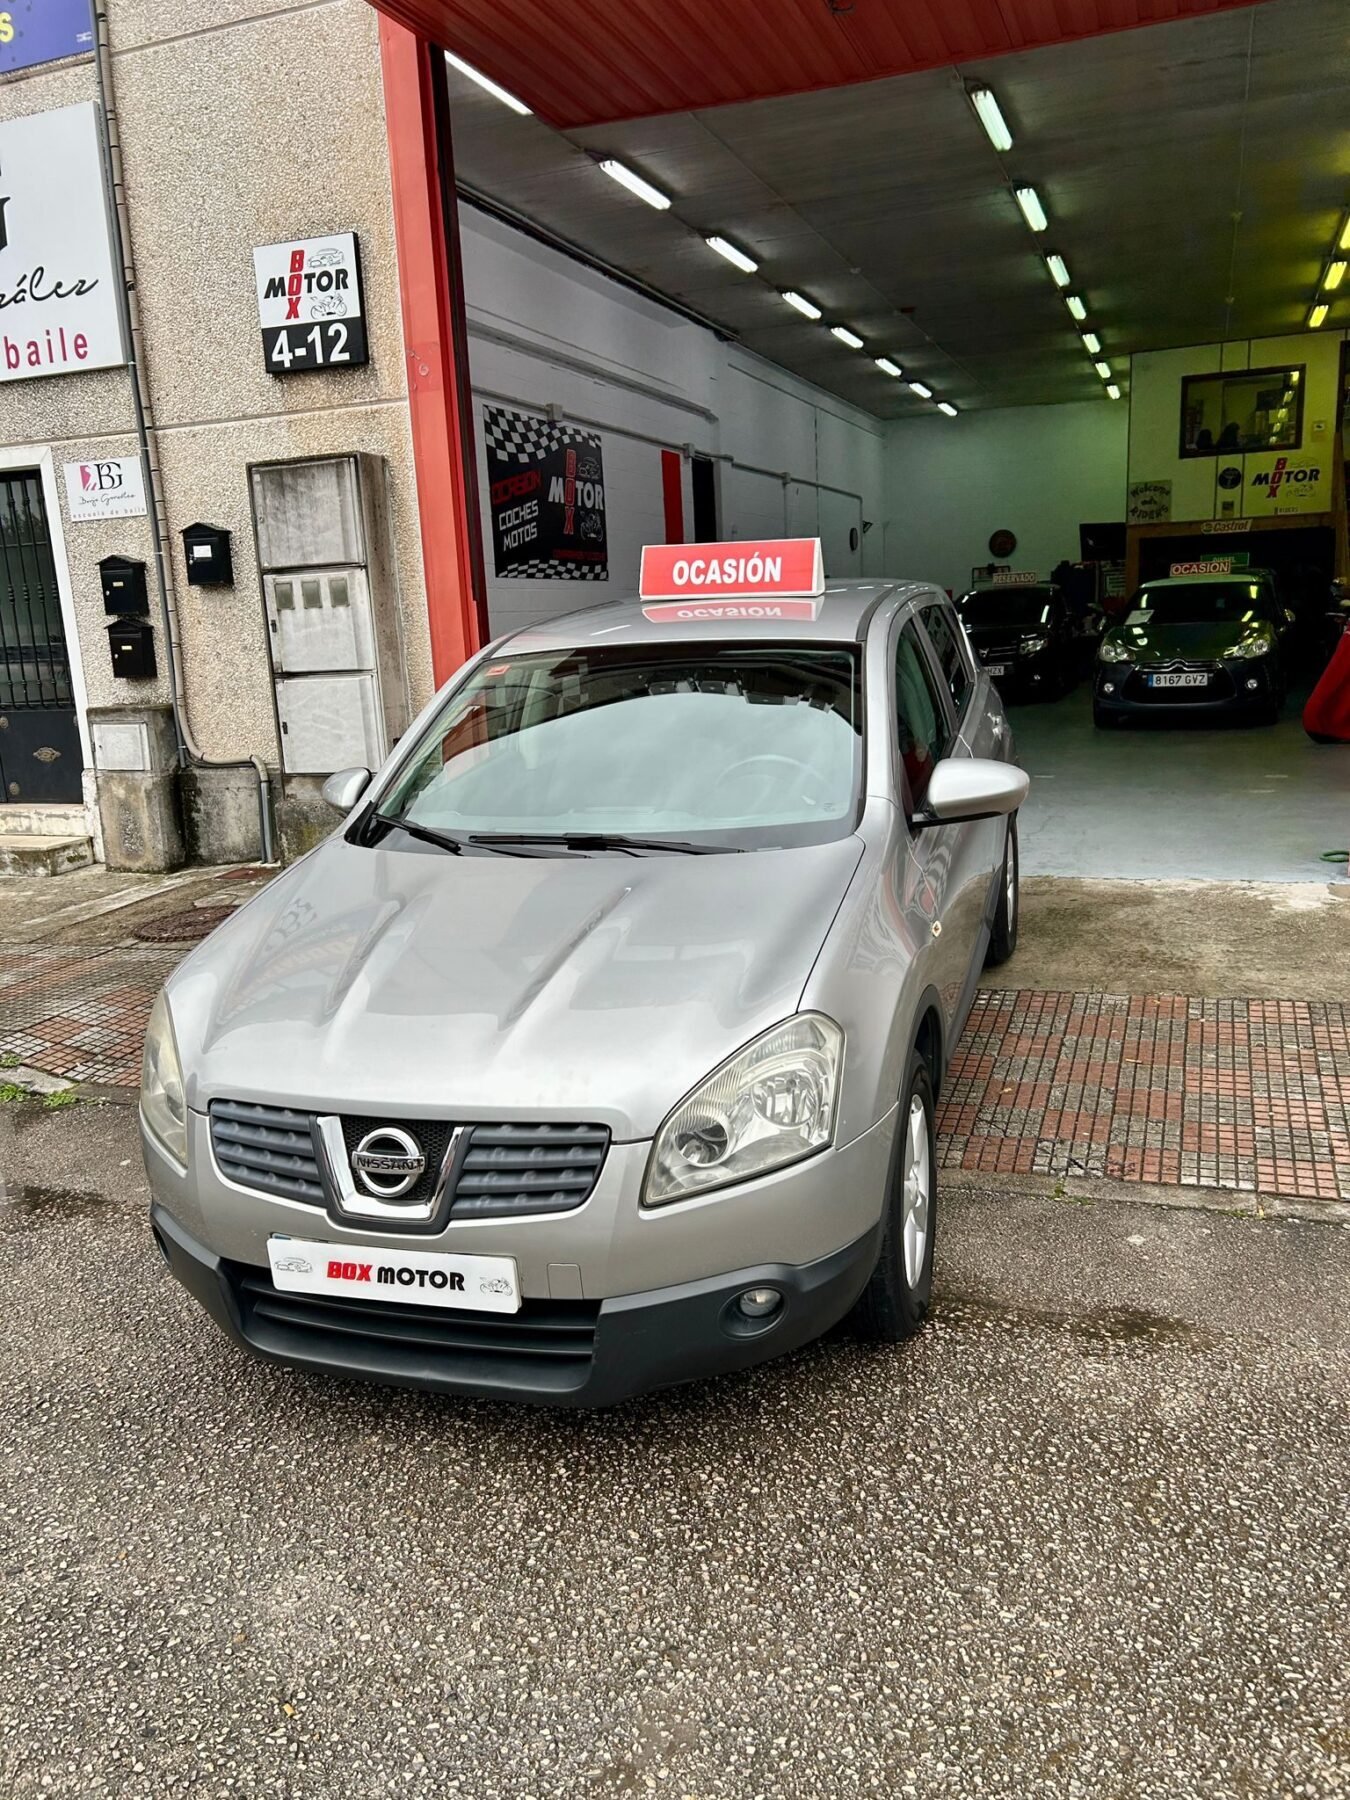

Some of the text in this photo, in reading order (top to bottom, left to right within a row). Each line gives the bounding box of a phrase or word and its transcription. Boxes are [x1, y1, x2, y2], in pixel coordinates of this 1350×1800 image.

[263, 268, 349, 299] MOTOR
[285, 249, 305, 320] BOX
[3, 327, 88, 369] baile
[271, 322, 350, 368] 4-12
[93, 461, 123, 490] BG
[1251, 468, 1320, 486] MOTOR
[547, 476, 604, 510] MOTOR
[498, 499, 539, 531] COCHES
[503, 521, 538, 552] MOTOS
[672, 551, 782, 586] OCASIÓN
[993, 572, 1036, 584] RESERVADO
[1155, 674, 1205, 685] 8167 GVZ
[357, 1157, 414, 1170] NISSAN
[326, 1261, 465, 1291] BOX MOTOR
